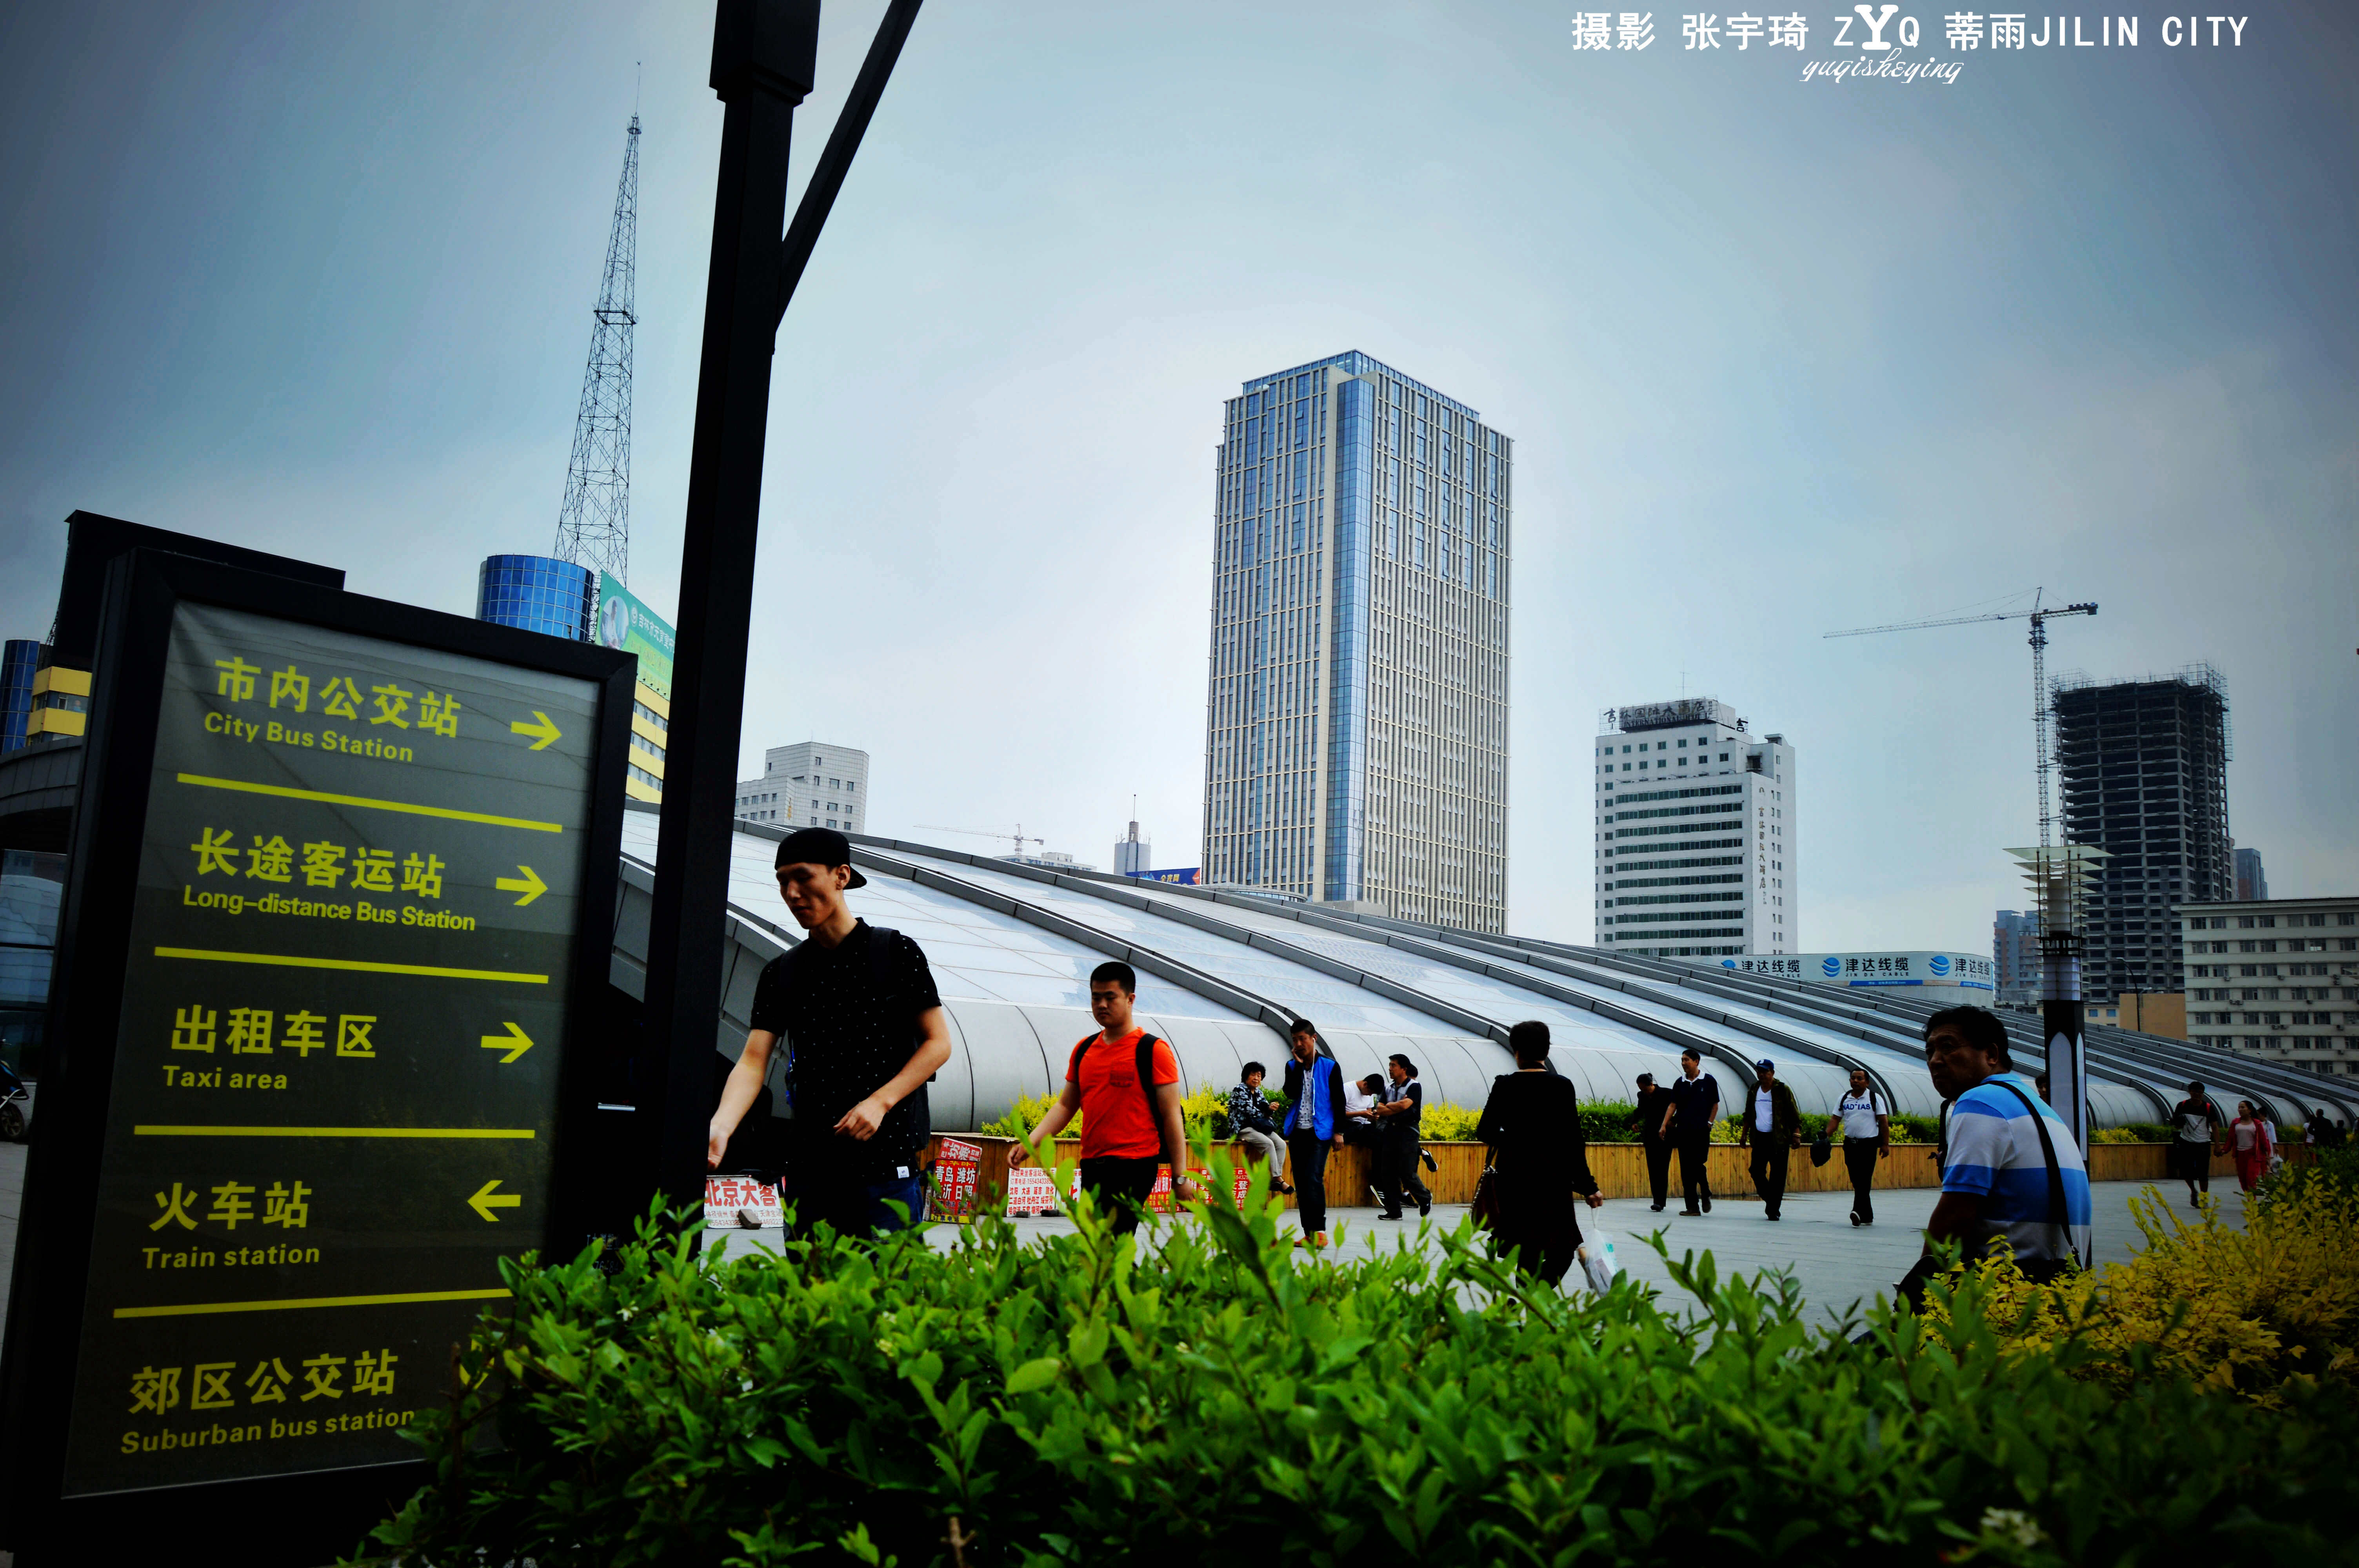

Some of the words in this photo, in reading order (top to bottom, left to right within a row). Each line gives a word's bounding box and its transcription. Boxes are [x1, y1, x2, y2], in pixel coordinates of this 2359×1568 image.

[214, 657, 461, 739] 市内公交站
[205, 712, 259, 743] City
[267, 722, 314, 748] Bus
[322, 730, 413, 762] Station
[191, 827, 445, 899] 长途客运站
[356, 902, 396, 924] Bus
[402, 906, 476, 931] Station
[1742, 960, 1801, 973] 津达线缆
[1845, 957, 1909, 972] 津达线缆
[1955, 958, 1990, 976] 津达线缆
[171, 1004, 377, 1058] 出租车区
[163, 1065, 222, 1088] Taxi
[229, 1073, 287, 1089] area
[935, 1166, 953, 1183] 青岛
[956, 1167, 976, 1184] 潍坊
[149, 1181, 312, 1232] 火车站
[705, 1179, 776, 1206] 北京大客
[142, 1247, 215, 1269] Train
[224, 1243, 320, 1266] station
[128, 1348, 399, 1417] 郊区公交站
[121, 1424, 261, 1454] Suburban
[270, 1418, 317, 1439] bus
[325, 1408, 414, 1434] station
